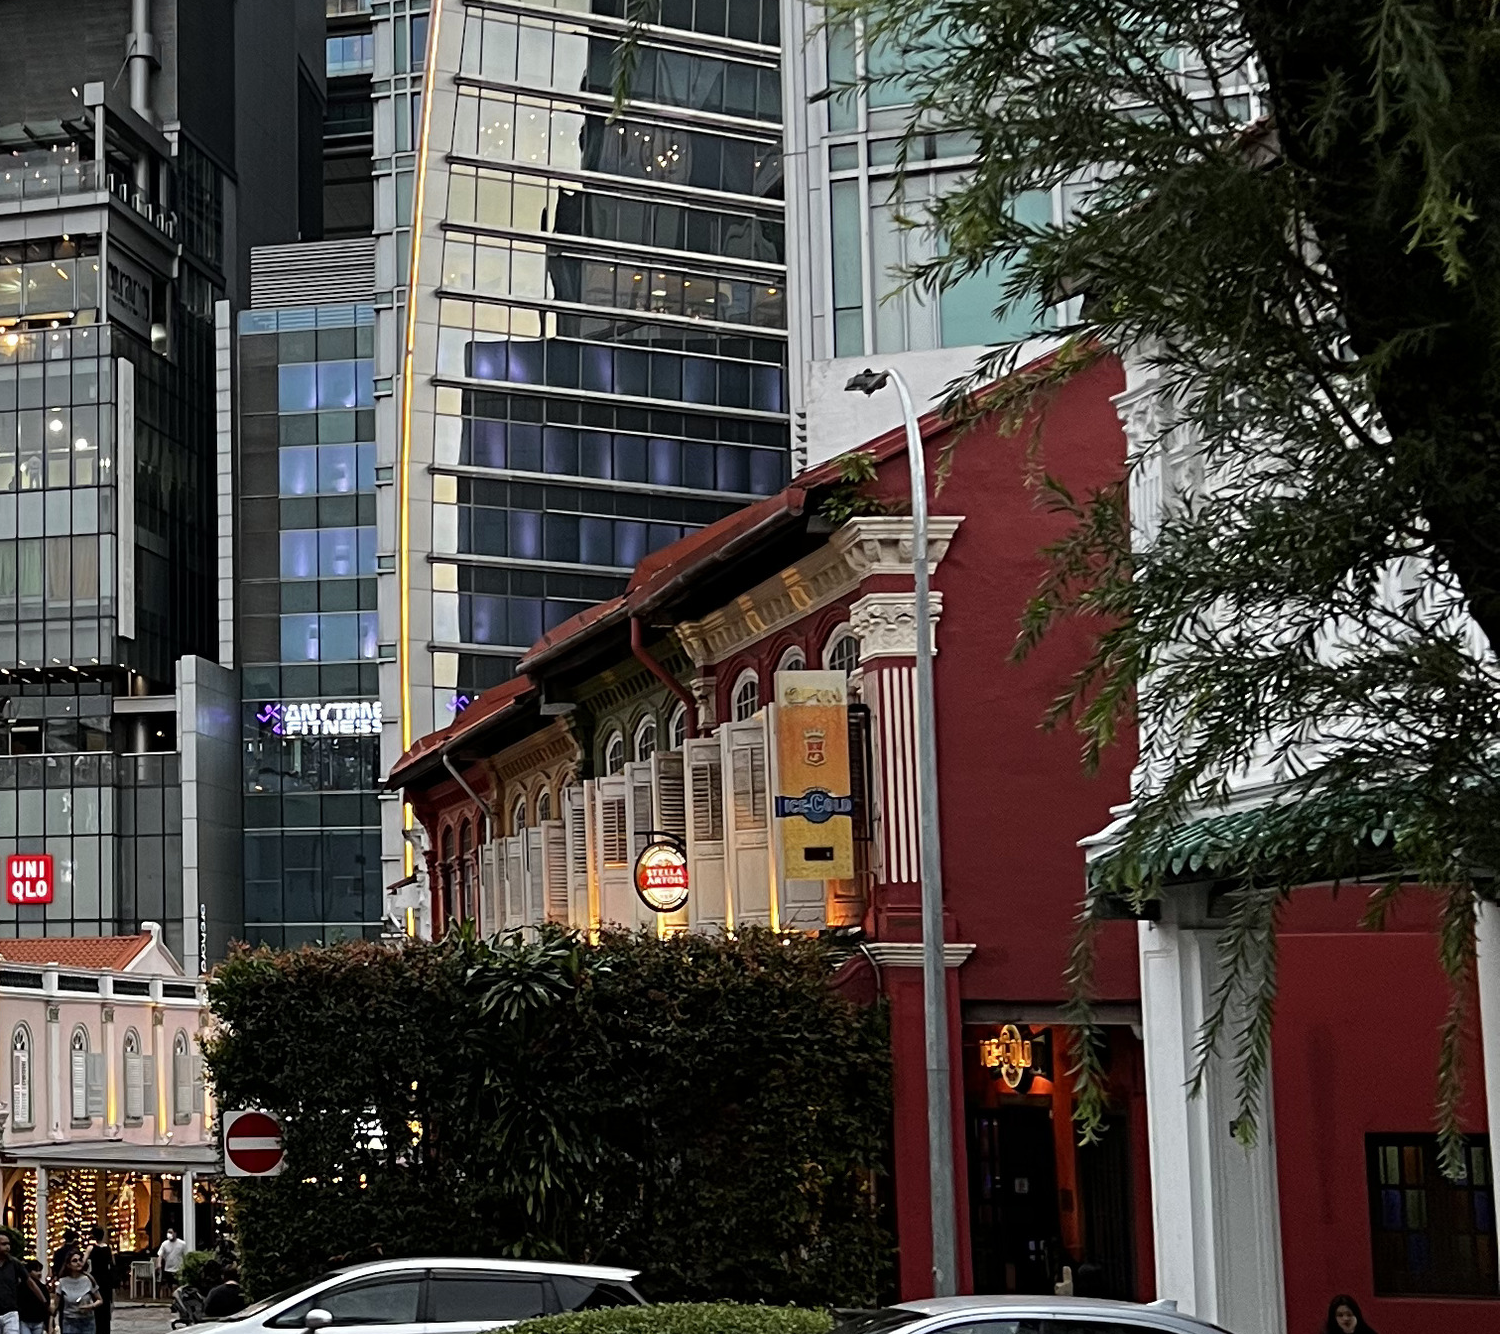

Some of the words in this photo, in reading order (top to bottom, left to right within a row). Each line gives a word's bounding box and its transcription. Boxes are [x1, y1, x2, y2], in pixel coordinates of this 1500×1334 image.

[285, 701, 382, 721] ANYTIME
[286, 719, 382, 735] FITNESS
[12, 860, 45, 878] UNI
[646, 868, 683, 877] STELLA
[647, 877, 685, 885] ARTOIS
[12, 880, 48, 901] QLO
